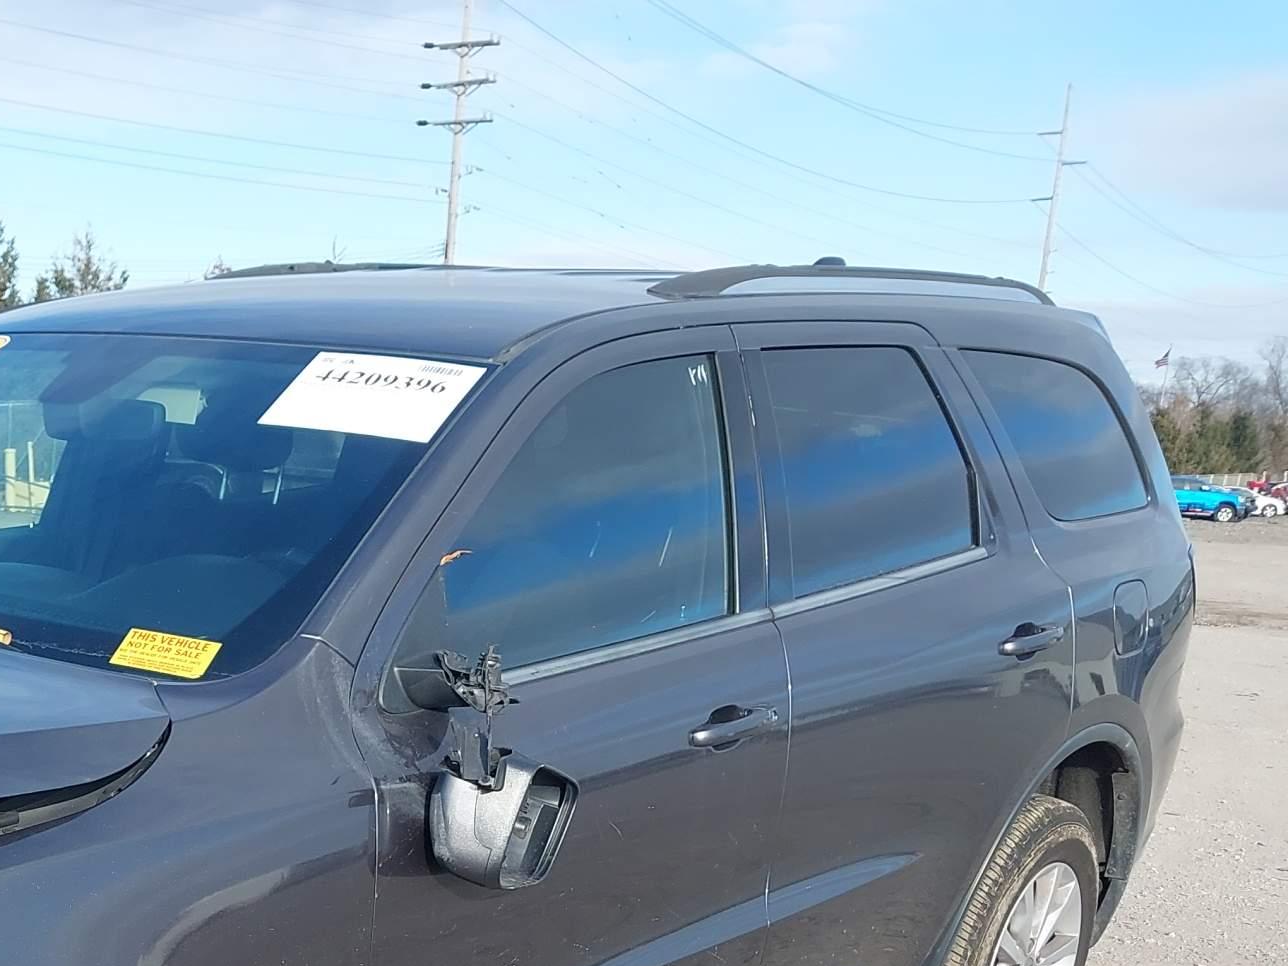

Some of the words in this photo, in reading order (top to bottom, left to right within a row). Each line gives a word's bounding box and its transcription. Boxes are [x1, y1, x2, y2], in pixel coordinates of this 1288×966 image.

[315, 367, 447, 394] 44209396
[126, 640, 150, 650] NOT
[150, 644, 173, 654] FOR
[174, 648, 202, 659] SALE
[130, 630, 158, 643] THIS
[161, 635, 212, 653] VEHICLE
